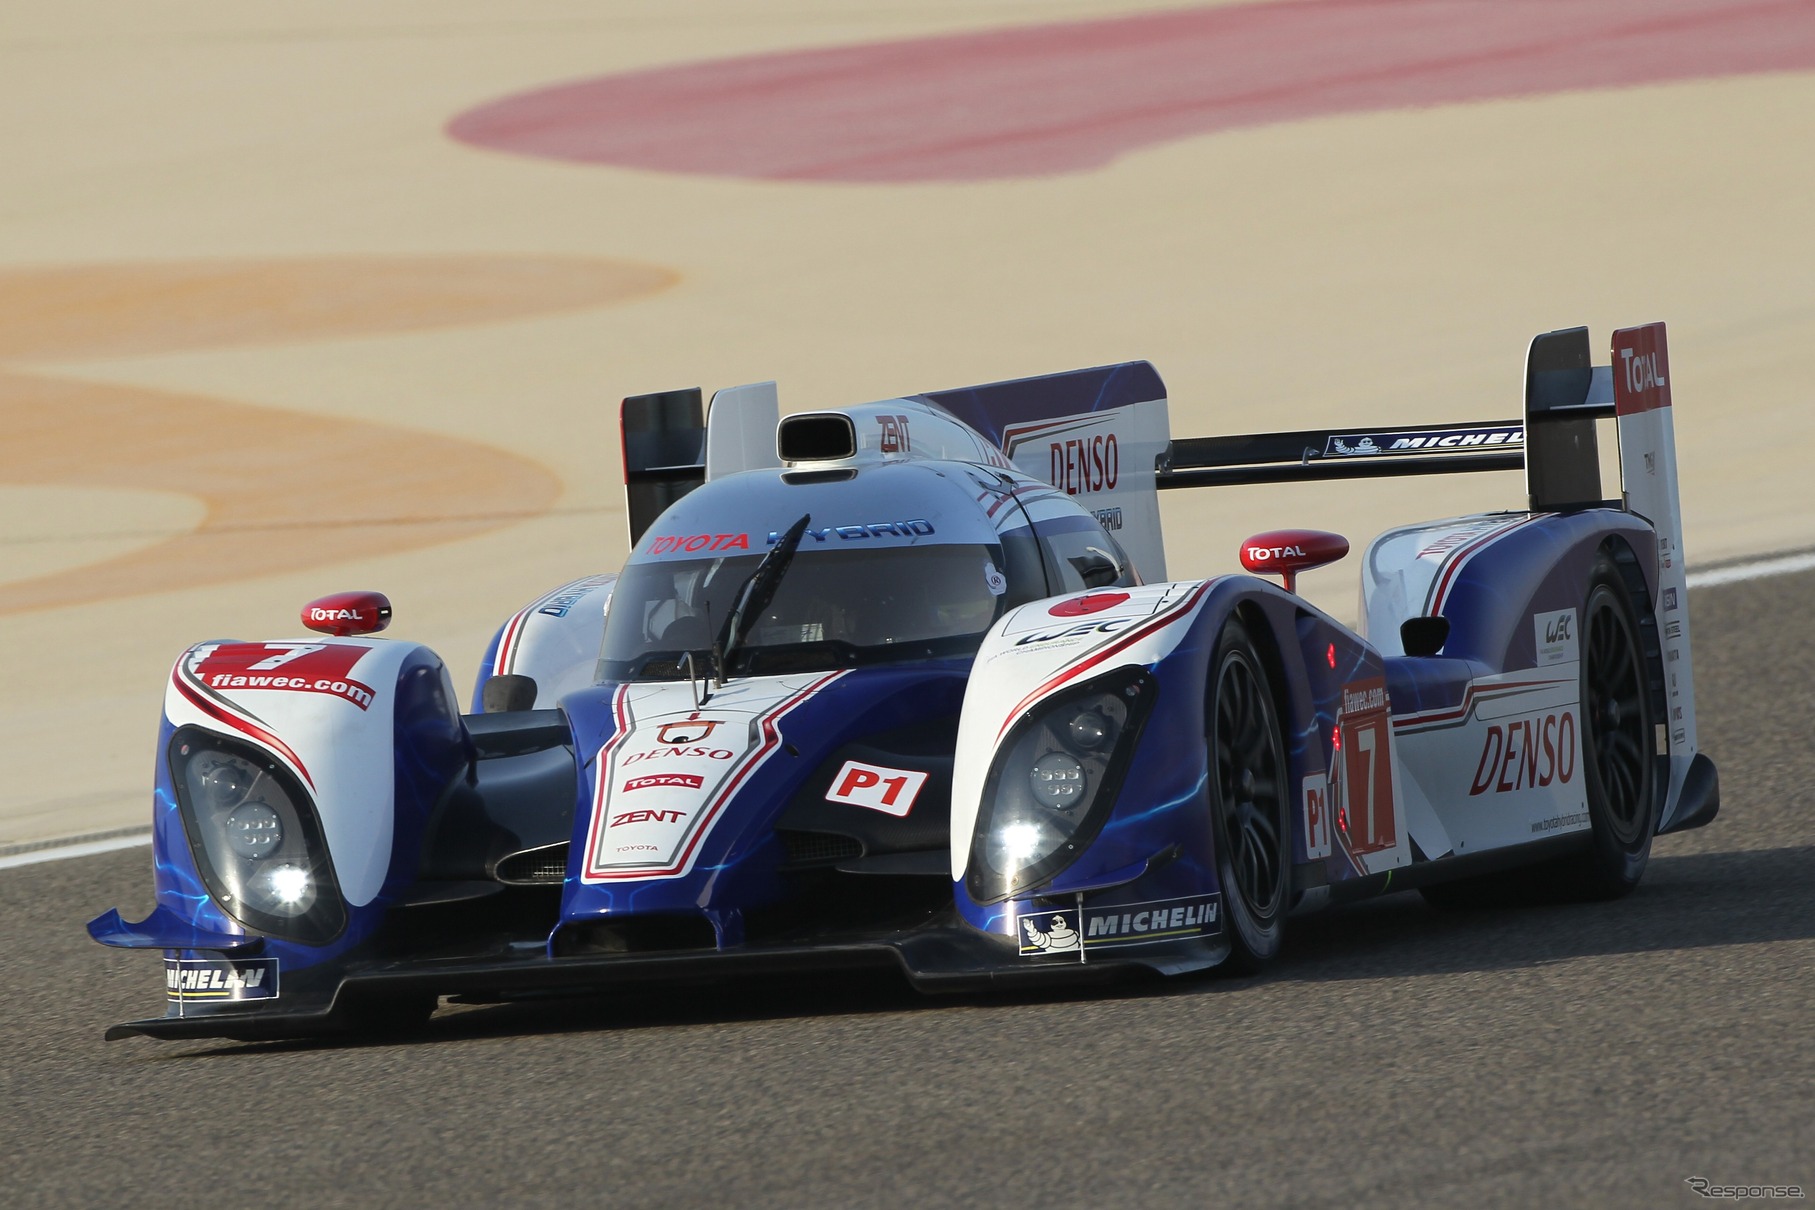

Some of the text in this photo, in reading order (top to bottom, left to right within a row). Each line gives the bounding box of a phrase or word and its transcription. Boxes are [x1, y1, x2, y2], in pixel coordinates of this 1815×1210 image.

[1621, 347, 1665, 394] TOTAL
[876, 415, 911, 453] ZENT
[1390, 431, 1524, 449] MICHEL
[1050, 433, 1119, 495] DENSO
[647, 533, 749, 555] TOYOTA
[1247, 545, 1306, 561] TOTAL
[310, 607, 363, 622] TOTAL
[1545, 614, 1572, 643] WEC
[1014, 618, 1132, 646] WEC
[246, 643, 327, 671] 7
[211, 673, 373, 708] fiawec.com
[1344, 687, 1384, 714] fiawec.com
[621, 746, 733, 768] DENSO
[1469, 711, 1576, 796] DENSO
[628, 777, 699, 789] TOTAL
[836, 768, 908, 806] P1
[1357, 727, 1376, 845] 7
[610, 809, 687, 828] ZENT
[1307, 786, 1328, 849] P1
[616, 844, 659, 852] TOYOTA
[1088, 902, 1218, 936] MICHELIN
